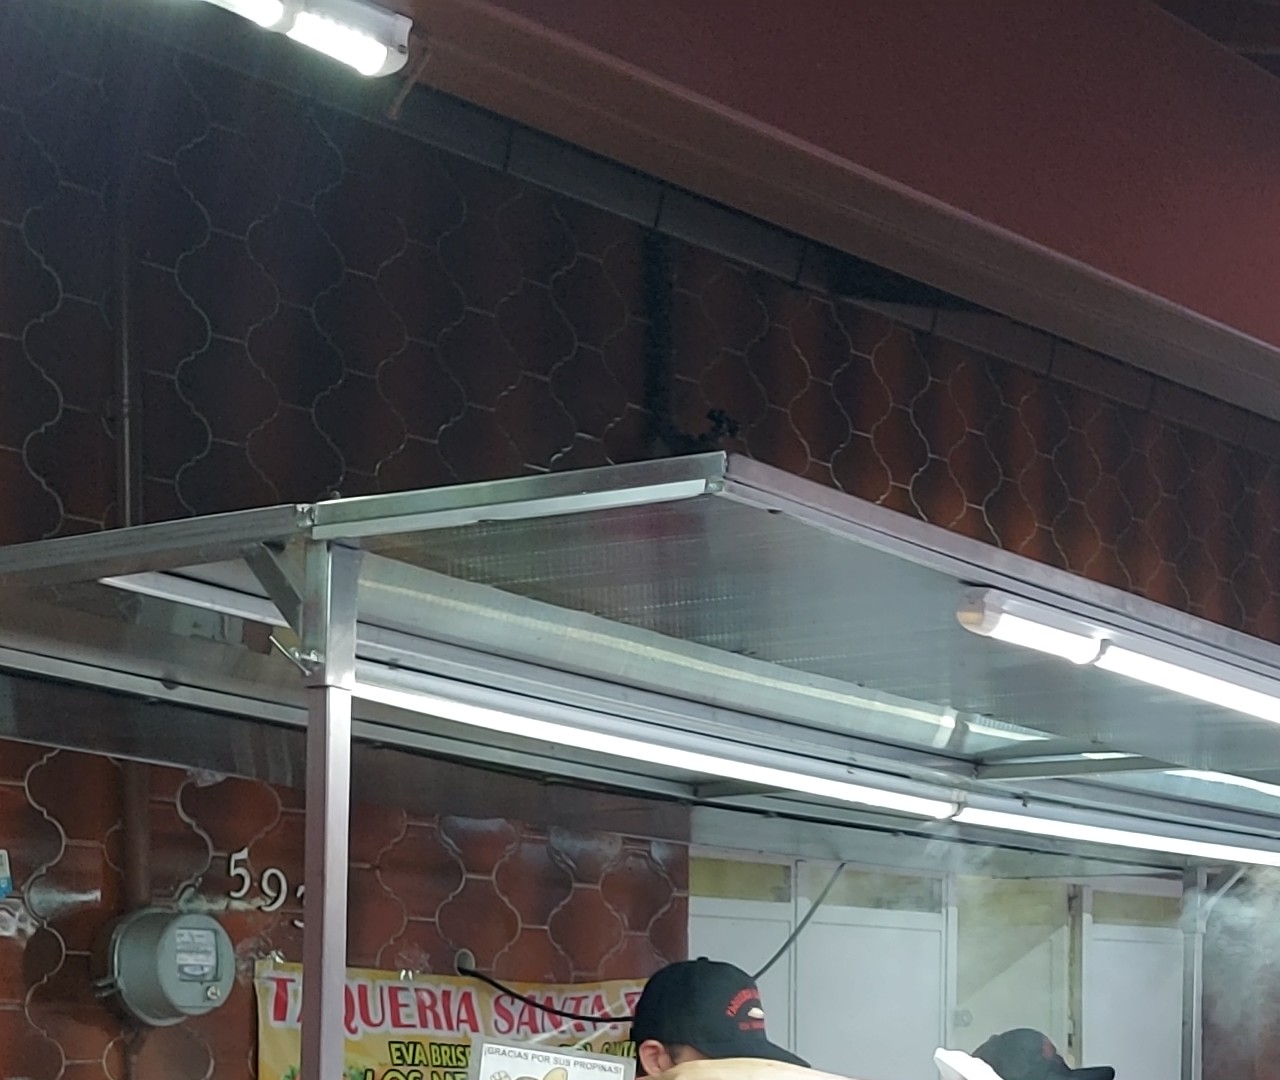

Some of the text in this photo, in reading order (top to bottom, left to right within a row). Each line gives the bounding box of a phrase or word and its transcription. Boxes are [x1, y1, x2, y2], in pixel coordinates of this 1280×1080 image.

[265, 976, 479, 1035] TQUERIA
[388, 1041, 428, 1067] EVA
[531, 1053, 551, 1064] POR
[553, 1056, 571, 1067] SUS
